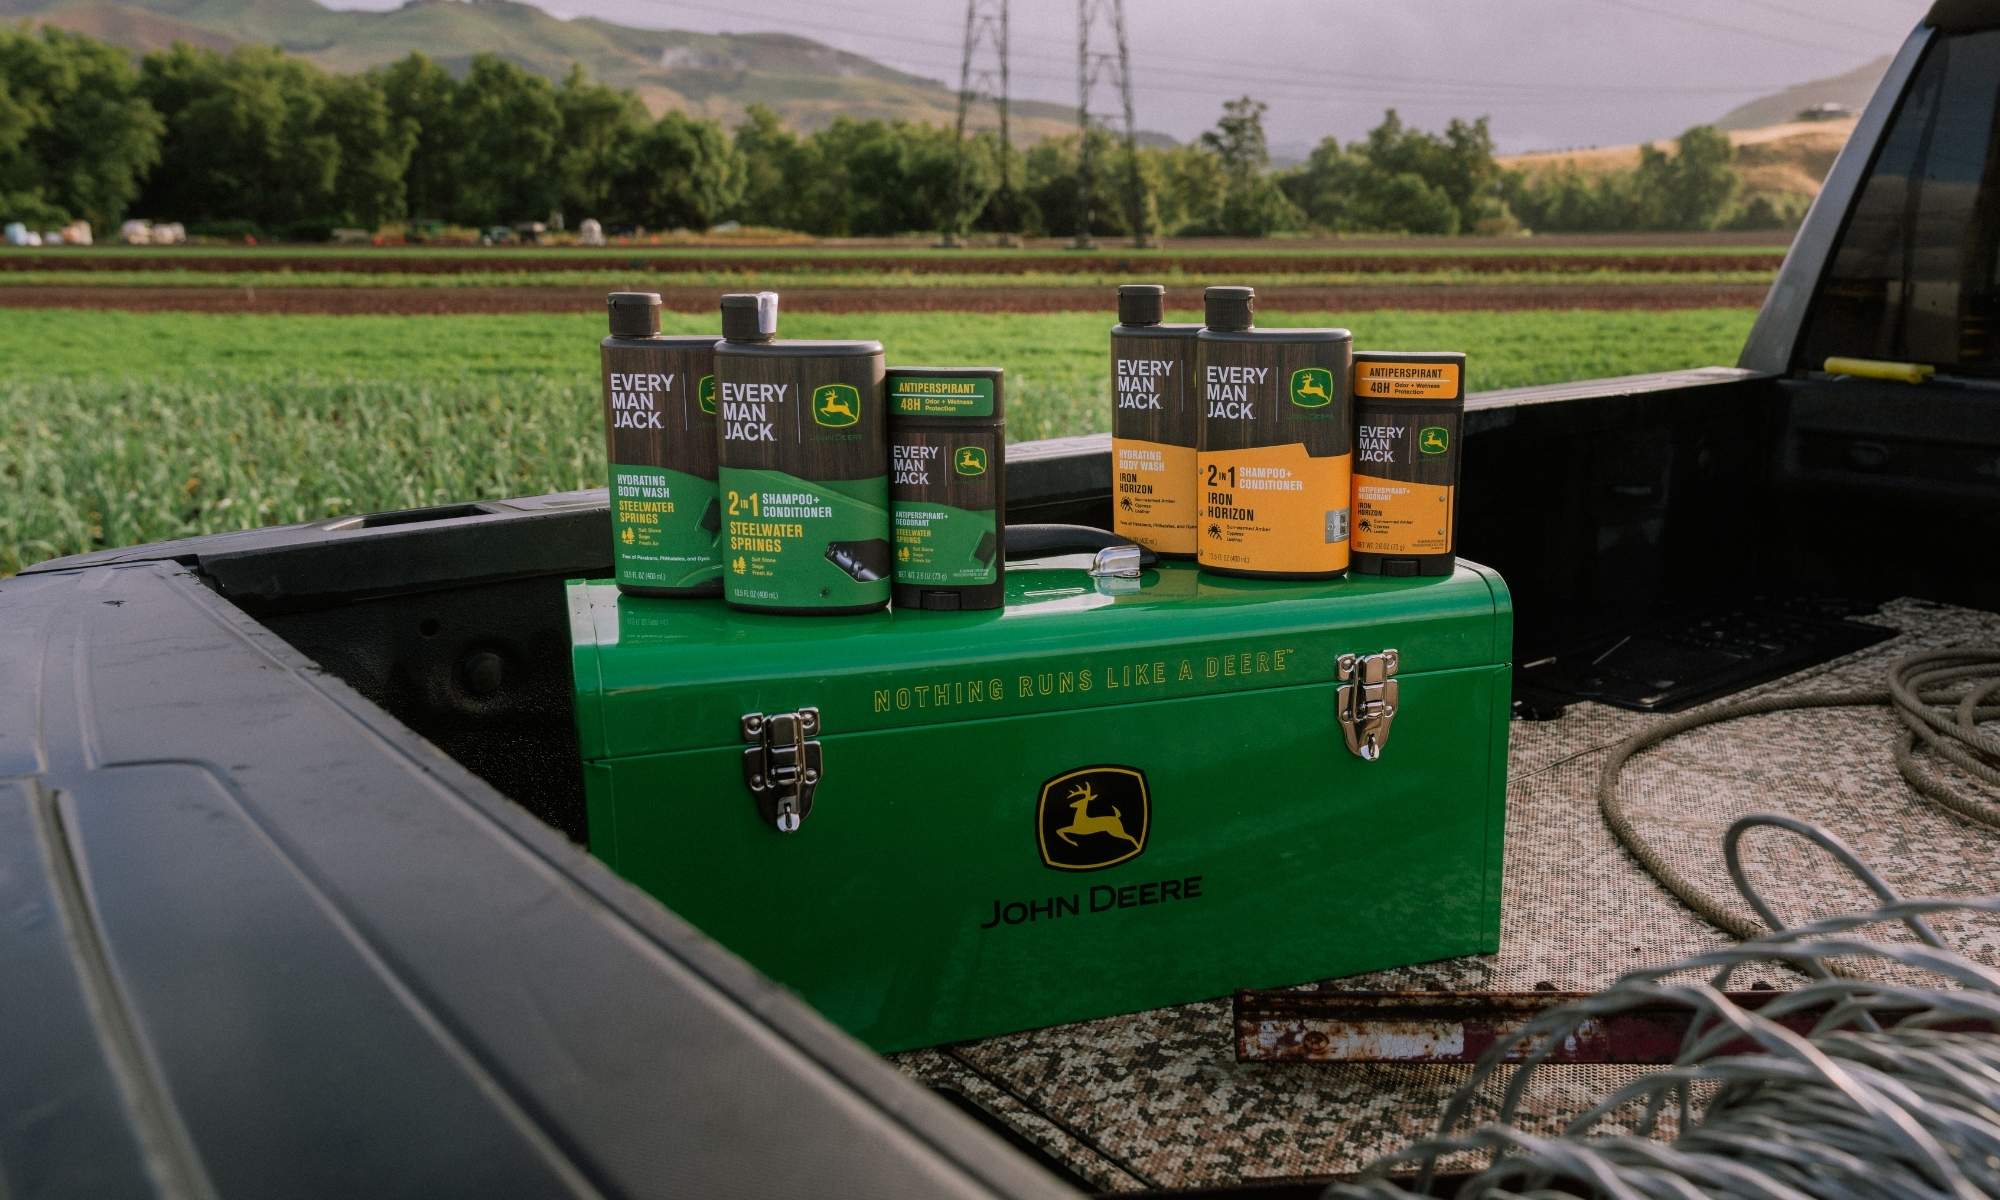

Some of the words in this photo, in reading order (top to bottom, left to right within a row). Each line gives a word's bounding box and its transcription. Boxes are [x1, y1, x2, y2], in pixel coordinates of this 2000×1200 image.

[1117, 359, 1173, 376] EVERY
[1369, 368, 1443, 379] ANTIPERSPIRANT
[1207, 366, 1268, 384] EVERY
[610, 373, 674, 392] EVERY
[899, 382, 976, 394] ANTIPERSPIRANT
[1118, 376, 1155, 393] MAN
[1370, 382, 1390, 393] 48H
[722, 383, 788, 402] EVERY
[1207, 384, 1247, 402] MAN
[612, 392, 654, 410] MAN
[900, 398, 920, 411] 48H
[723, 403, 766, 422] MAN
[1359, 425, 1405, 439] EVERY
[1360, 438, 1390, 450] MAN
[893, 445, 939, 459] EVERY
[1120, 449, 1162, 460] HYDRATING
[894, 459, 924, 471] MAN
[1120, 460, 1138, 470] BODY
[1140, 461, 1164, 472] WASH
[617, 474, 665, 486] HYDRATING
[1120, 473, 1136, 482] IRON
[1120, 483, 1153, 494] HORIZON
[1240, 479, 1303, 491] CONDITIONER
[618, 486, 640, 496] BODY
[642, 487, 670, 498] WASH
[1208, 492, 1232, 505] IRON
[619, 500, 675, 512] STEELWATER
[763, 506, 832, 518] CONDITIONER
[620, 512, 658, 524] SPRINGS
[1208, 506, 1254, 521] HORIZON
[730, 521, 804, 538] STEELWATER
[731, 537, 782, 553] SPRINGS
[874, 678, 1003, 713] NOTHING
[1019, 669, 1093, 698] RUNS
[1107, 661, 1166, 689] LIKE
[1179, 659, 1193, 680] A
[980, 894, 1079, 929] JOHN
[1090, 875, 1203, 913] DEERE
